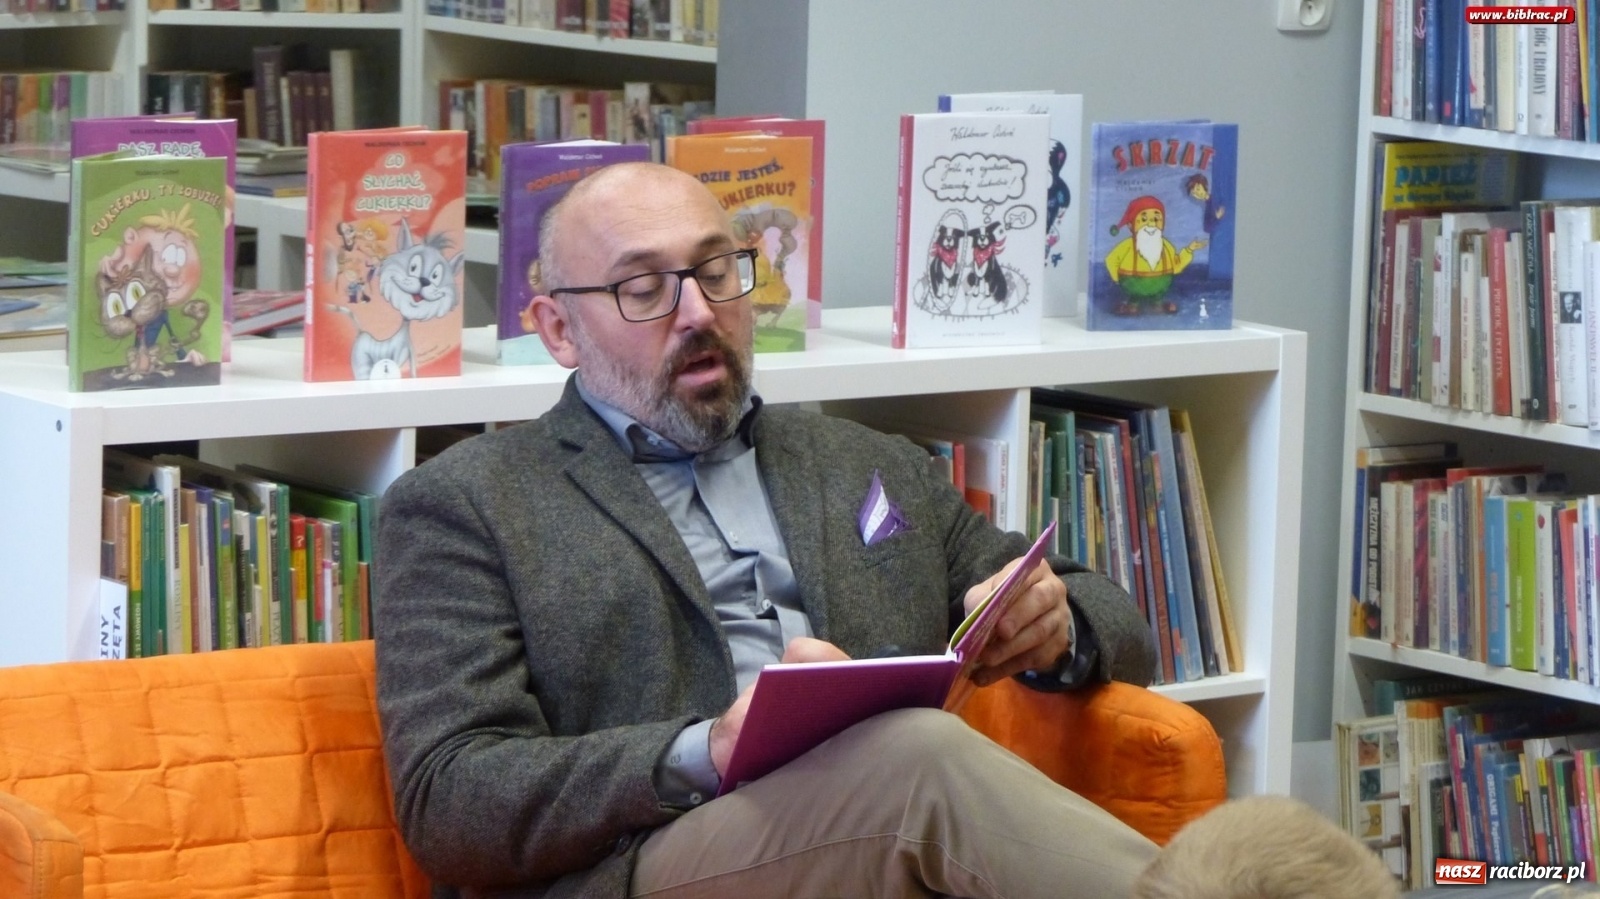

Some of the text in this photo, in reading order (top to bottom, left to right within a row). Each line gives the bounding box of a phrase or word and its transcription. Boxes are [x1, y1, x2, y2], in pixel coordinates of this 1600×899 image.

[385, 153, 404, 168] CO
[1112, 138, 1216, 173] SKRZAT
[158, 184, 176, 197] TY
[694, 171, 731, 184] DZIE
[718, 181, 796, 211] UKIERKU?
[1368, 497, 1379, 545] MĘŻCZYZNA
[1486, 774, 1498, 816] ORIGAMI
